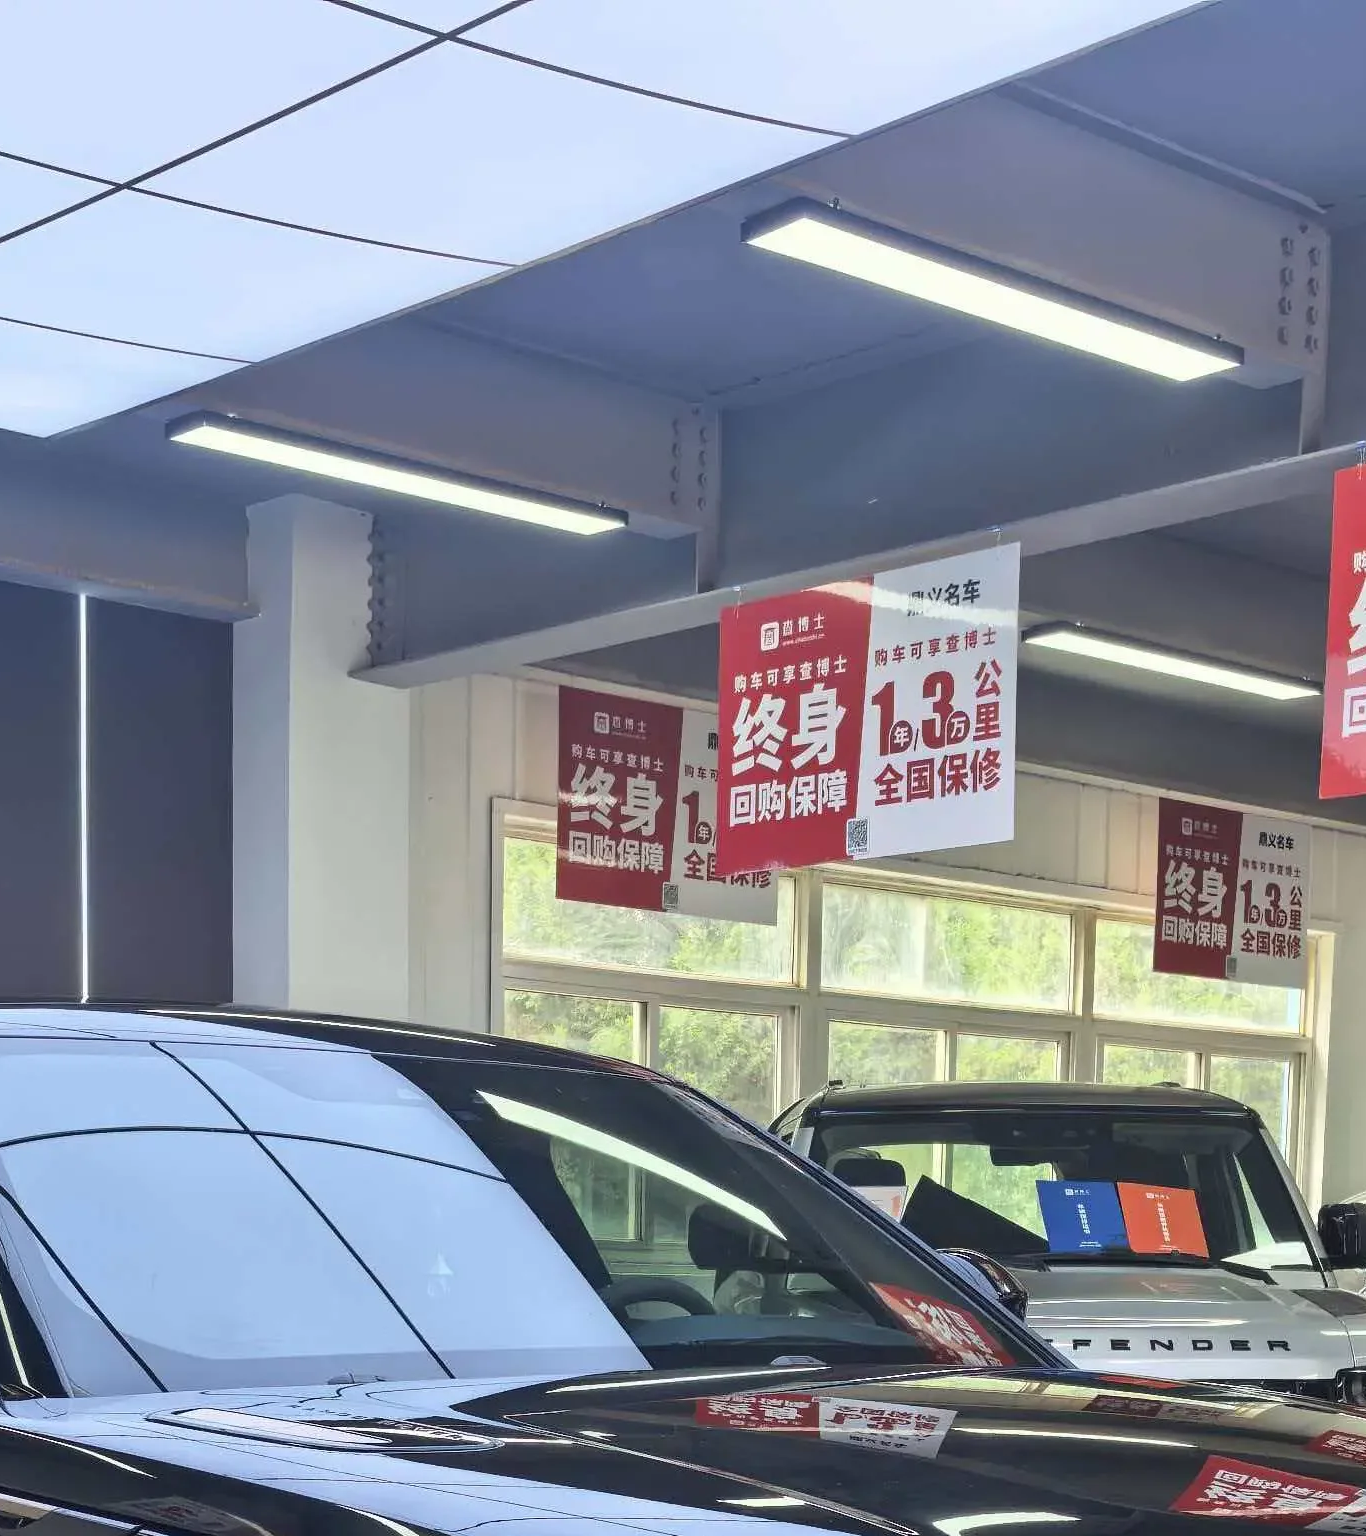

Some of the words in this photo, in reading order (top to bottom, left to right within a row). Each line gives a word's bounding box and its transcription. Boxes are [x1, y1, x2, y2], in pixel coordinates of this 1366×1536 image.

[874, 627, 997, 668] 购车可享查博士
[734, 654, 848, 694] 购车可享查博士
[731, 682, 847, 777] 终身
[571, 743, 665, 773] 购车可享查博士
[873, 747, 1002, 807] 全国保修
[570, 762, 664, 837] 终身
[729, 769, 848, 827] 回购保障
[568, 830, 665, 875] 回购保障
[1258, 831, 1295, 851] 鼎义名车
[1164, 859, 1228, 918] 终身
[1162, 914, 1228, 950] 回购保障
[1240, 927, 1302, 959] 全国保修
[1046, 1338, 1291, 1352] FENDER
